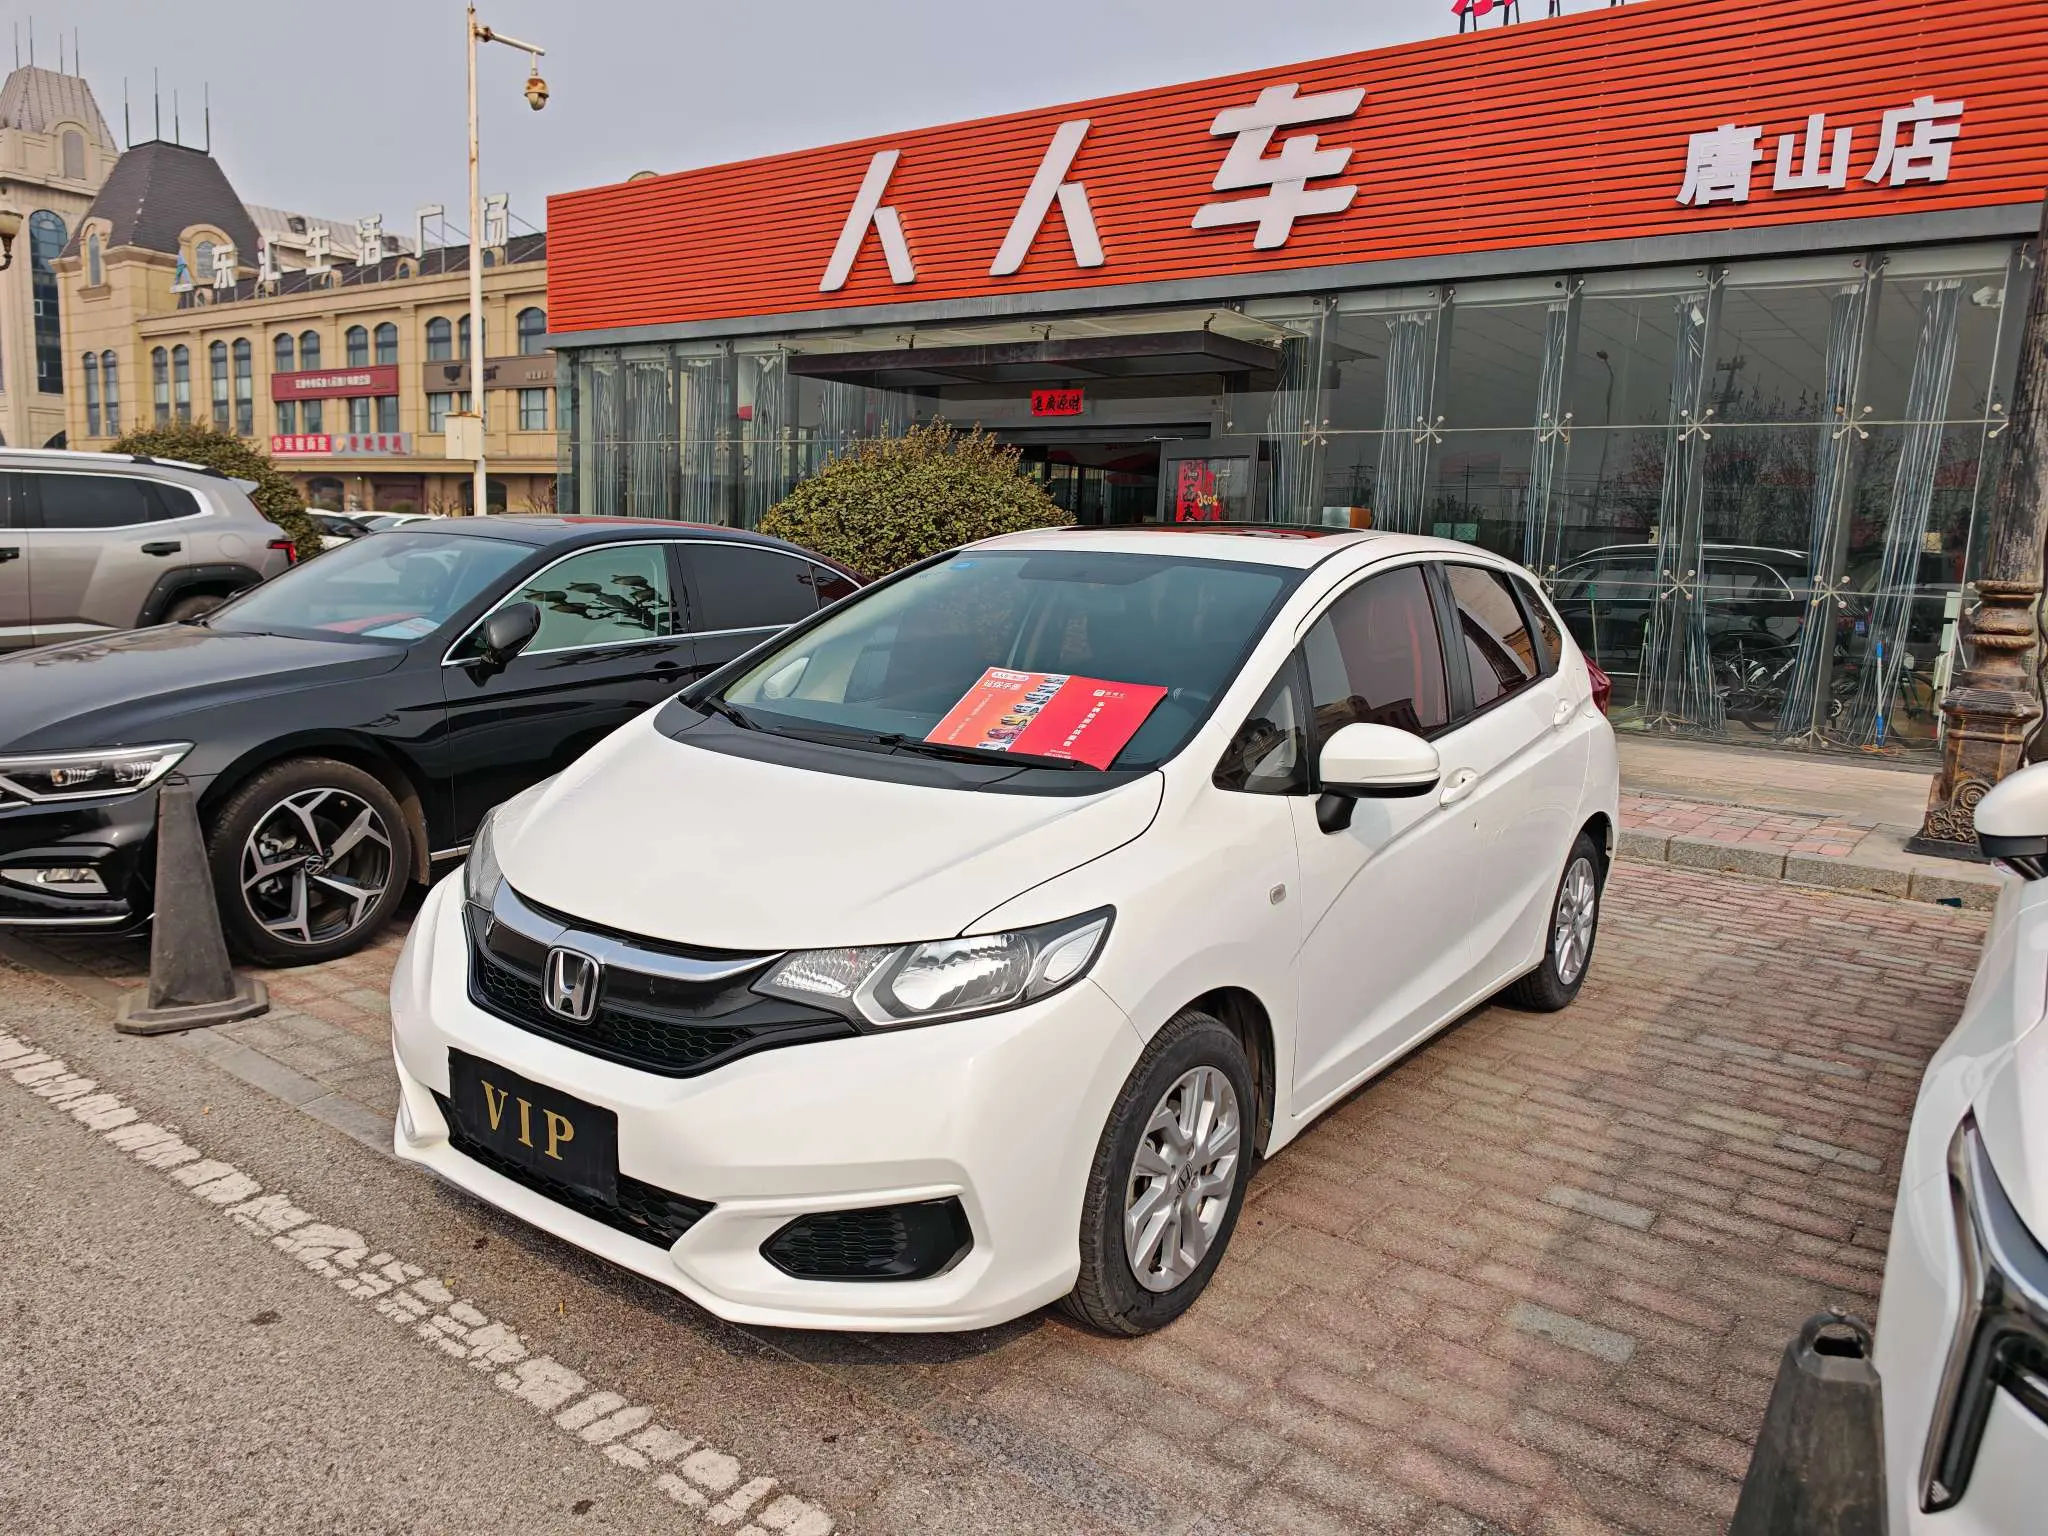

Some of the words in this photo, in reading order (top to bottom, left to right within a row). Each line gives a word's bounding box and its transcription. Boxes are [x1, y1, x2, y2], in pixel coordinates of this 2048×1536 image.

[819, 82, 1366, 292] 人人车
[1676, 95, 1964, 206] 唐山店
[481, 1079, 575, 1161] VIP
